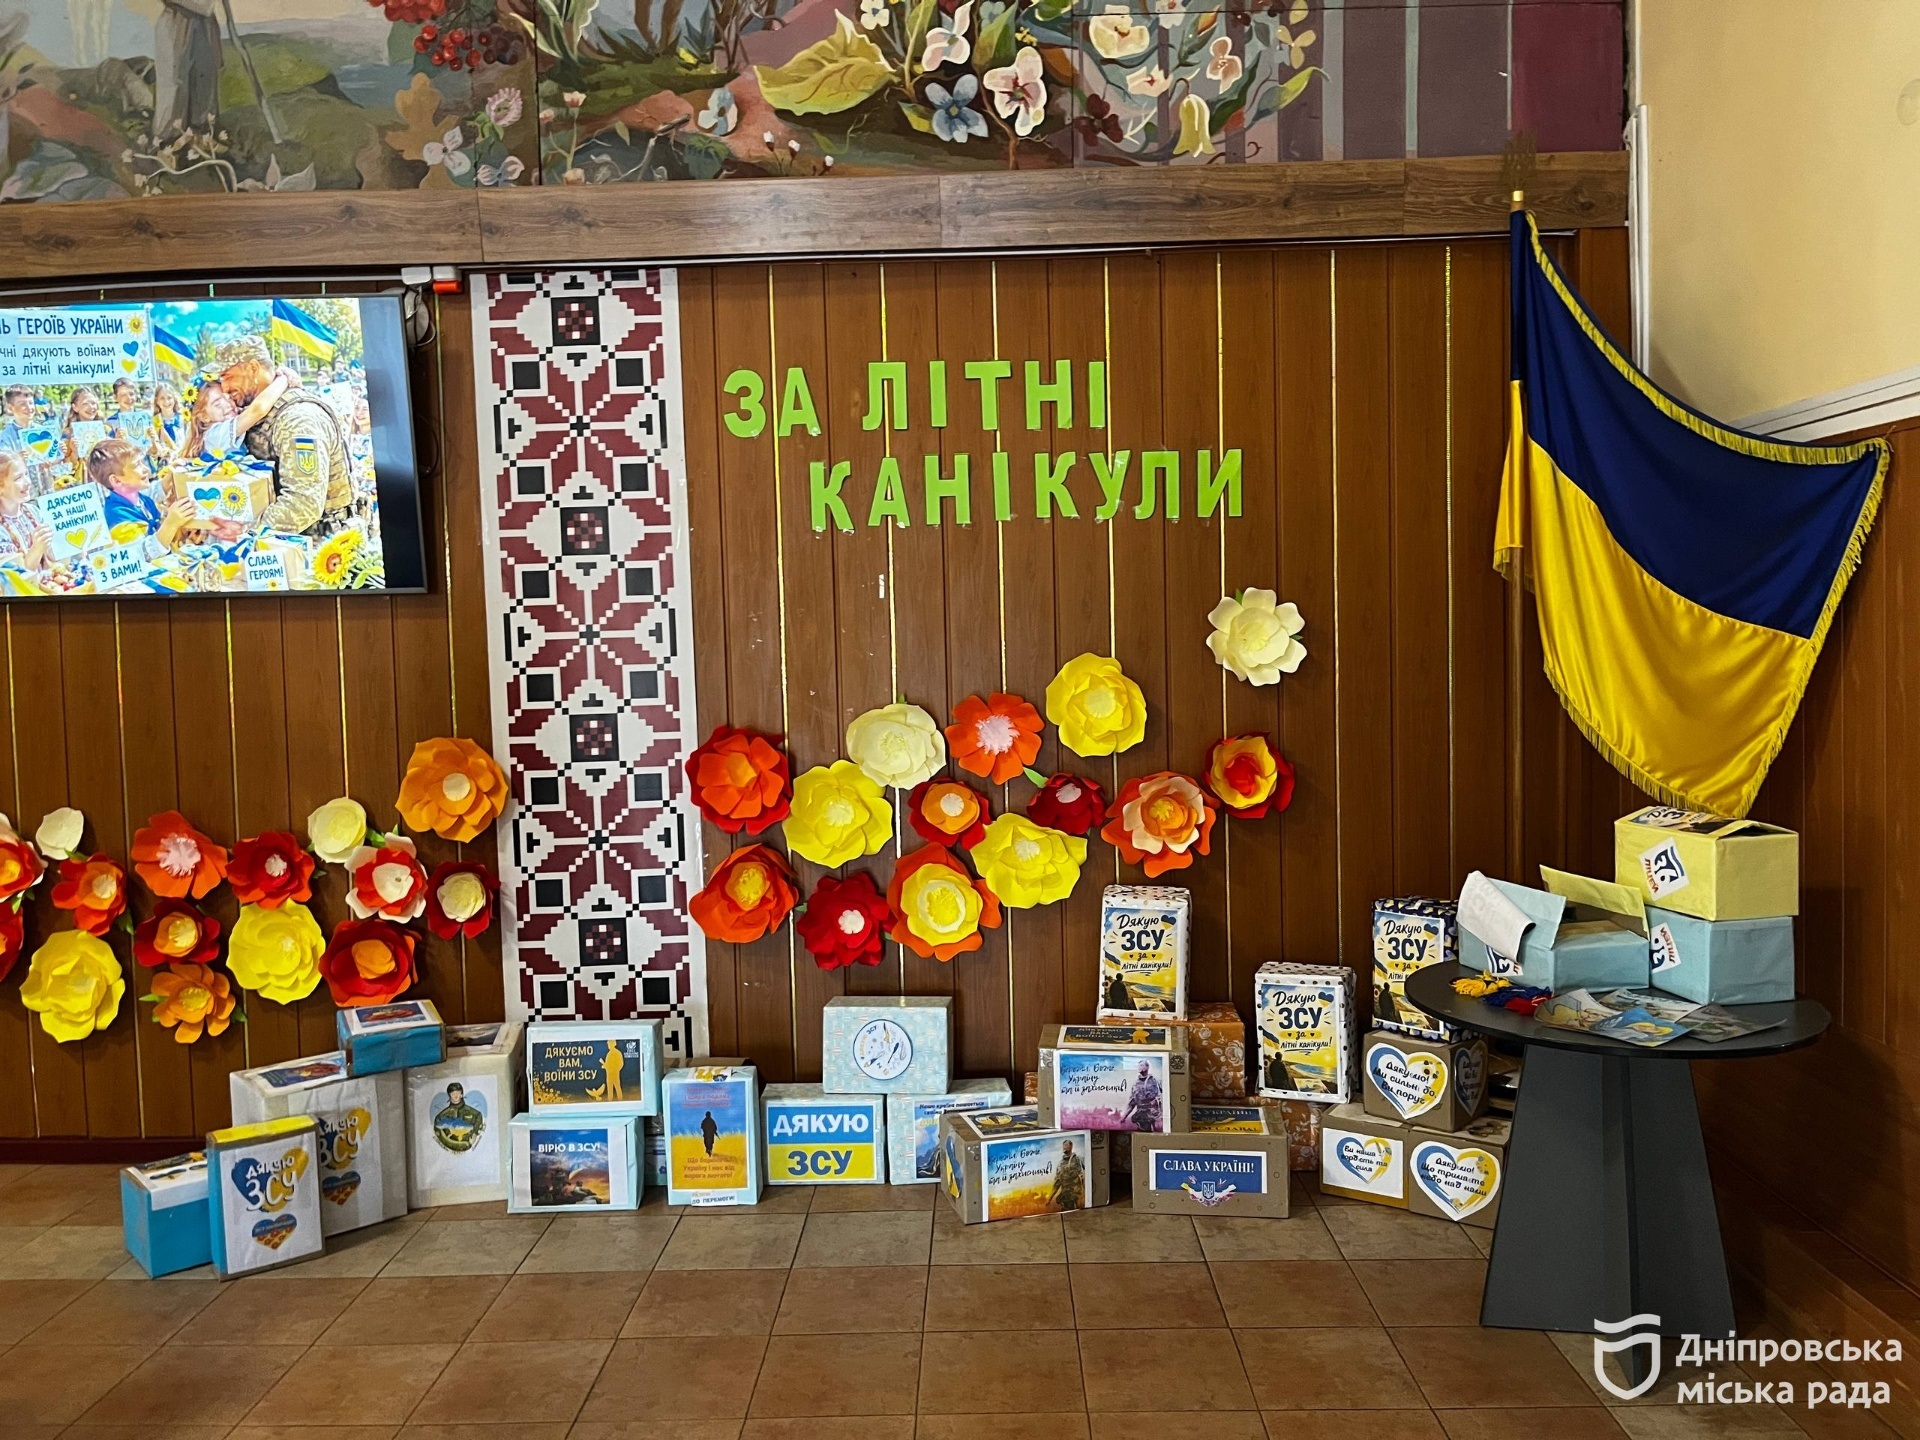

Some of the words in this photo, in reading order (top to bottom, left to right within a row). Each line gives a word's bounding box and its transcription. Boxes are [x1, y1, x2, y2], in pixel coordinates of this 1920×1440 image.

[17, 314, 66, 335] ГЕРОЇВ
[70, 314, 124, 335] УКРАЇНИ
[22, 346, 71, 361] дякують
[77, 344, 115, 357] воїнам
[2, 365, 16, 376] за
[22, 362, 51, 375] літні
[58, 360, 115, 378] канікули!
[722, 367, 822, 439] ЗА
[862, 359, 1106, 431] ЛІТНІ
[809, 448, 1243, 531] КАНІКУЛИ
[46, 490, 93, 511] ДЯКУЄМО
[52, 511, 64, 520] ЗА
[66, 503, 87, 515] НАШІ
[55, 511, 99, 531] КАНІКУЛИ!
[248, 555, 279, 567] СЛАВА
[100, 571, 108, 583] З
[110, 560, 143, 579] ВАМИ!
[249, 567, 284, 580] ГЕРОЯМ!
[1117, 914, 1160, 929] Дякую
[1383, 920, 1422, 938] Дякую
[1121, 929, 1165, 951] ЗСУ
[1137, 953, 1148, 962] за
[1387, 937, 1428, 961] ЗСУ
[1121, 962, 1139, 970] літні
[1140, 957, 1173, 972] канікули!
[1402, 963, 1412, 972] за
[1273, 991, 1316, 1007] Дякую
[1278, 1007, 1323, 1029] ЗСУ
[1280, 1040, 1297, 1049] літні
[1299, 1036, 1332, 1051] канікули!
[1296, 1031, 1306, 1040] за
[545, 1045, 594, 1058] ДЯКУЄМО
[559, 1058, 583, 1068] ВАМ,
[544, 1069, 576, 1082] ВОЇНИ
[578, 1070, 598, 1081] ЗСУ
[773, 1113, 869, 1137] ДЯКУЮ
[538, 1143, 566, 1153] ВІРЮ
[568, 1143, 575, 1152] В
[577, 1142, 600, 1152] ЗСУ!
[788, 1150, 853, 1176] ЗСУ
[1163, 1159, 1201, 1172] СЛАВА
[1204, 1159, 1255, 1173] УКРАЇНІ!
[245, 1170, 299, 1211] ЗСУ
